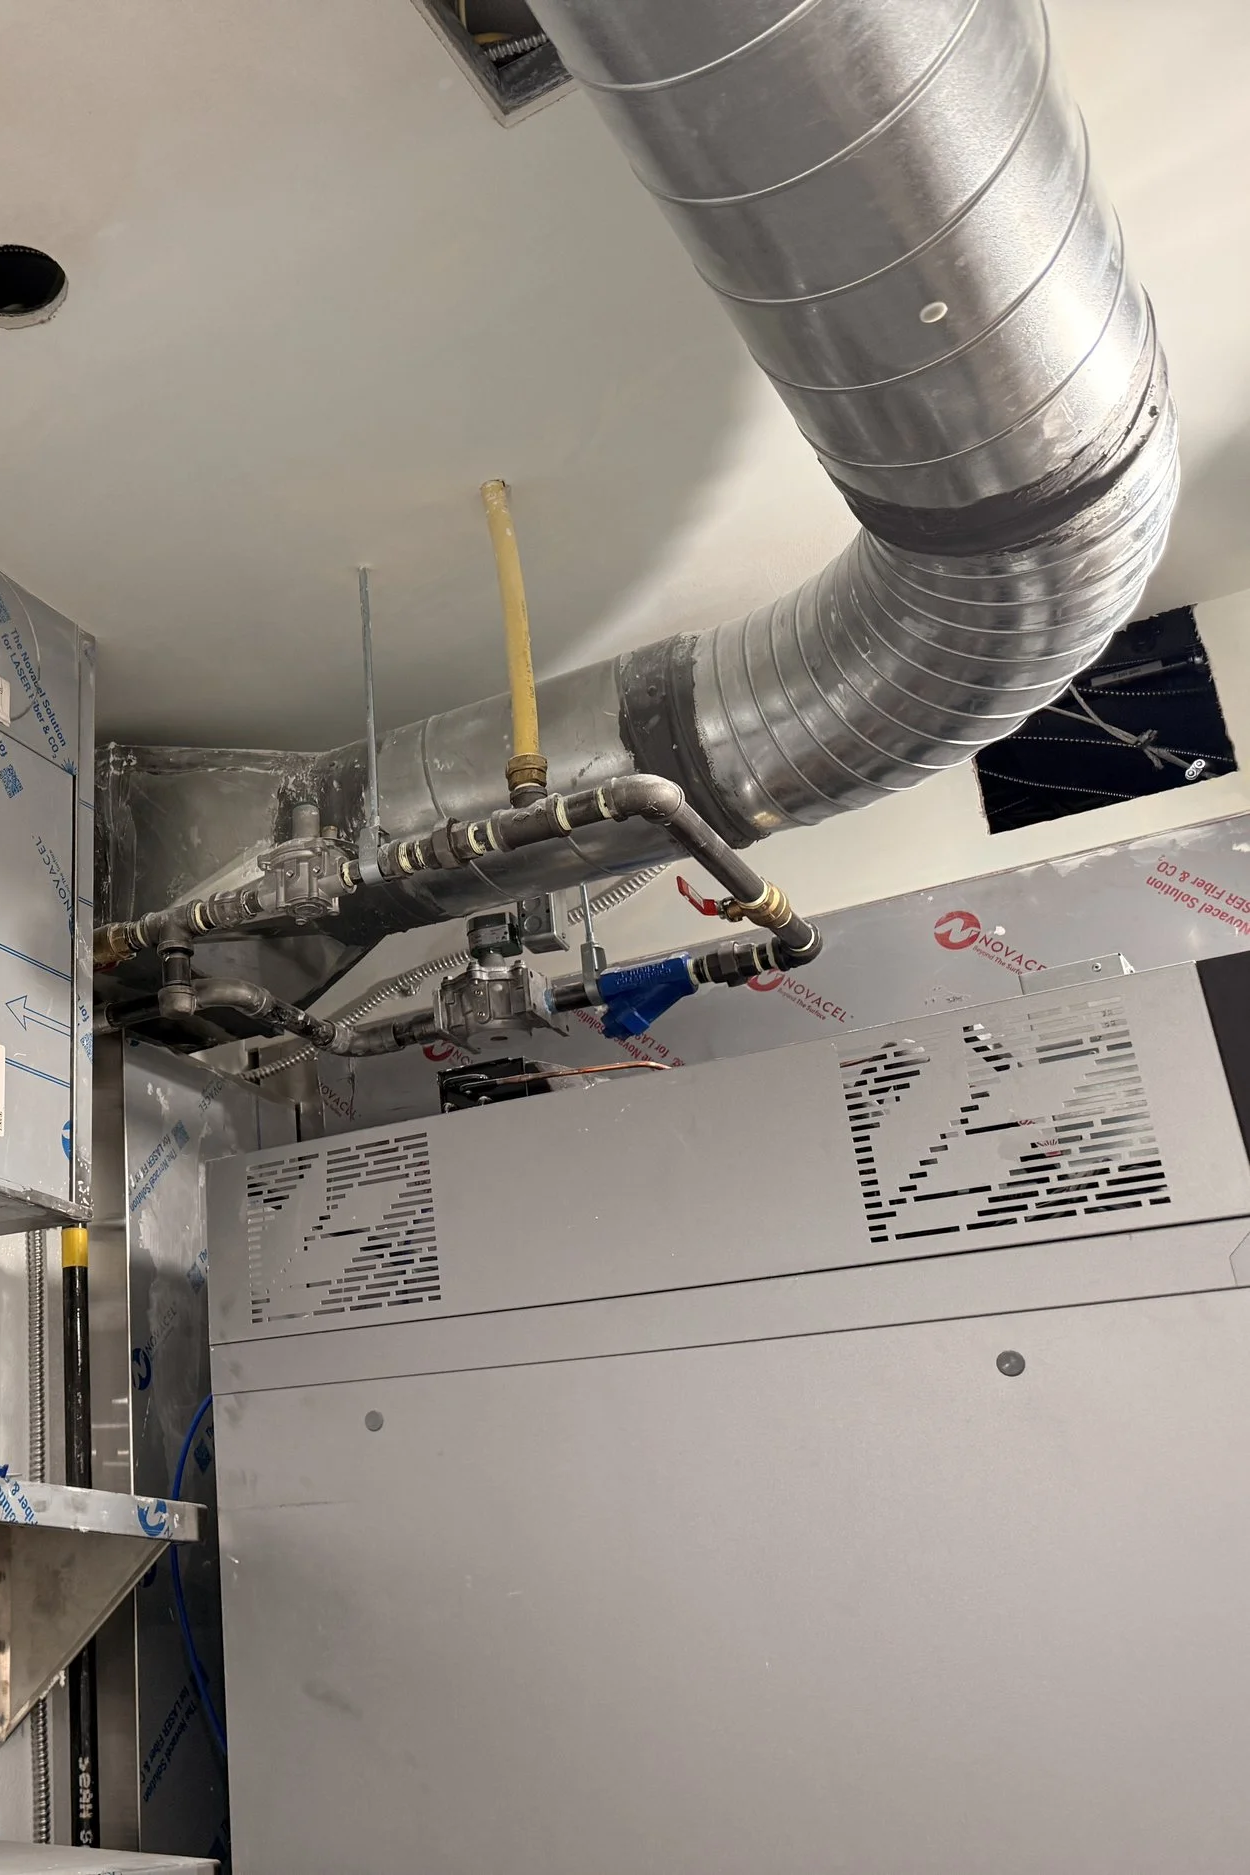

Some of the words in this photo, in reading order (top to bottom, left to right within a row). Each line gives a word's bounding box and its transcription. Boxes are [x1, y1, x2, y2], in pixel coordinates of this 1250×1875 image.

[1, 633, 13, 651] for
[10, 652, 32, 693] LASER
[42, 725, 51, 735] &
[10, 627, 23, 650] The
[21, 652, 46, 698] Novacel
[42, 699, 67, 747] Solution
[34, 835, 72, 912] NOVACEL
[1178, 870, 1190, 883] &
[1190, 877, 1226, 900] Fiber
[1146, 876, 1199, 909] Solution
[1198, 902, 1250, 935] Novacel
[972, 944, 994, 963] Beyond
[993, 956, 1006, 969] The
[783, 978, 847, 1023] NOVACEL
[654, 1046, 670, 1059] for
[129, 1183, 151, 1212] Solution
[11, 1481, 21, 1496] &
